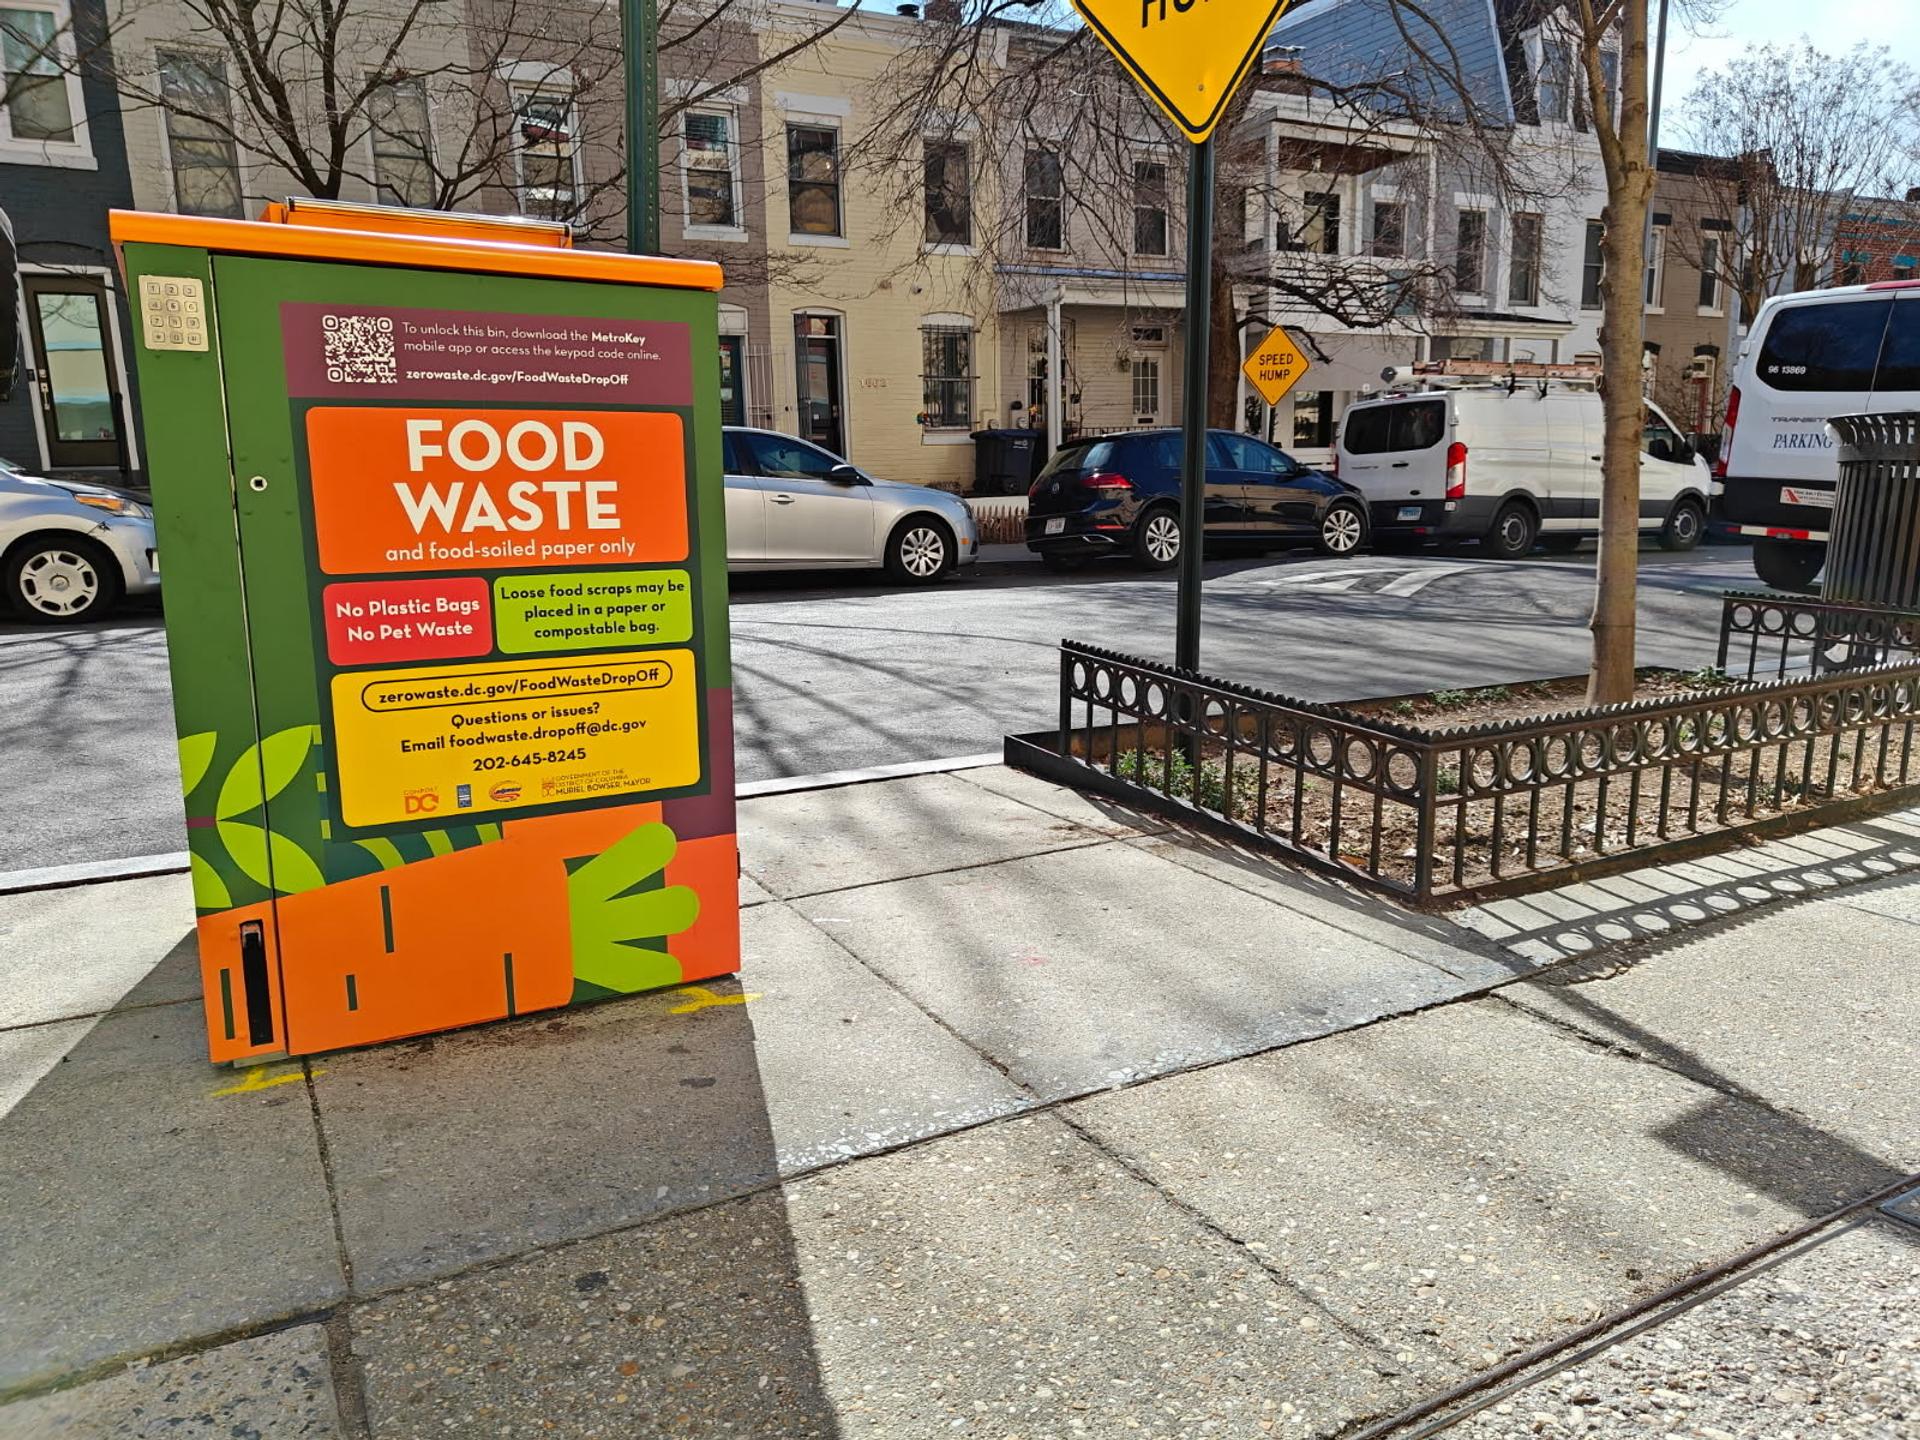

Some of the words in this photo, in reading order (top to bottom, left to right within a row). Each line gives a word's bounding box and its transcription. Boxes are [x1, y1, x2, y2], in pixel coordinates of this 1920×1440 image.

[401, 322, 417, 334] To
[420, 323, 459, 335] unlock
[463, 325, 484, 336] this
[487, 326, 508, 339] bin,
[512, 327, 568, 340] download
[570, 330, 588, 341] the
[591, 332, 646, 346] MetroKey
[404, 340, 445, 352] mobile
[449, 344, 472, 355] app
[476, 345, 488, 354] or
[491, 346, 530, 356] access
[533, 345, 551, 356] the
[554, 346, 594, 360] keypad
[598, 348, 624, 359] code
[627, 349, 661, 361] online.
[1259, 353, 1294, 366] SPEED
[406, 369, 629, 387] zerowaste.dc.gov/FoodWasteDropOff
[1259, 369, 1291, 381] HUMP
[1767, 365, 1779, 374] 96
[406, 419, 605, 472] FOOD
[1773, 433, 1833, 449] PARKING
[393, 481, 621, 534] WASTE
[386, 543, 423, 562] and
[429, 539, 535, 560] food-soiled
[541, 542, 594, 560] paper
[600, 537, 636, 557] only
[501, 586, 545, 600] Loose
[550, 584, 583, 598] food
[586, 584, 632, 600] scraps
[636, 583, 664, 596] may
[668, 580, 685, 592] be
[336, 602, 363, 618] No
[369, 599, 431, 617] Plastic
[436, 597, 480, 616] Bags
[525, 603, 573, 622] placed
[577, 603, 591, 616] in
[594, 606, 603, 615] a
[607, 604, 650, 619] paper
[653, 602, 666, 613] or
[348, 626, 375, 642] No
[380, 624, 411, 640] Pet
[417, 621, 473, 637] Waste
[534, 621, 625, 639] compostable
[630, 619, 660, 636] bag.
[378, 668, 660, 704] zerowaste.dc.gov/FoodWasteDropOff
[451, 711, 527, 729] Questions
[531, 710, 547, 721] or
[551, 702, 600, 718] issues?
[401, 736, 445, 753] Email
[449, 718, 647, 748] foodwaste.dropoff@dc.gov
[473, 747, 587, 772] 202-645-8245
[555, 785, 585, 795] MURIEL
[624, 777, 651, 786] MAYOR
[404, 793, 440, 814] DC
